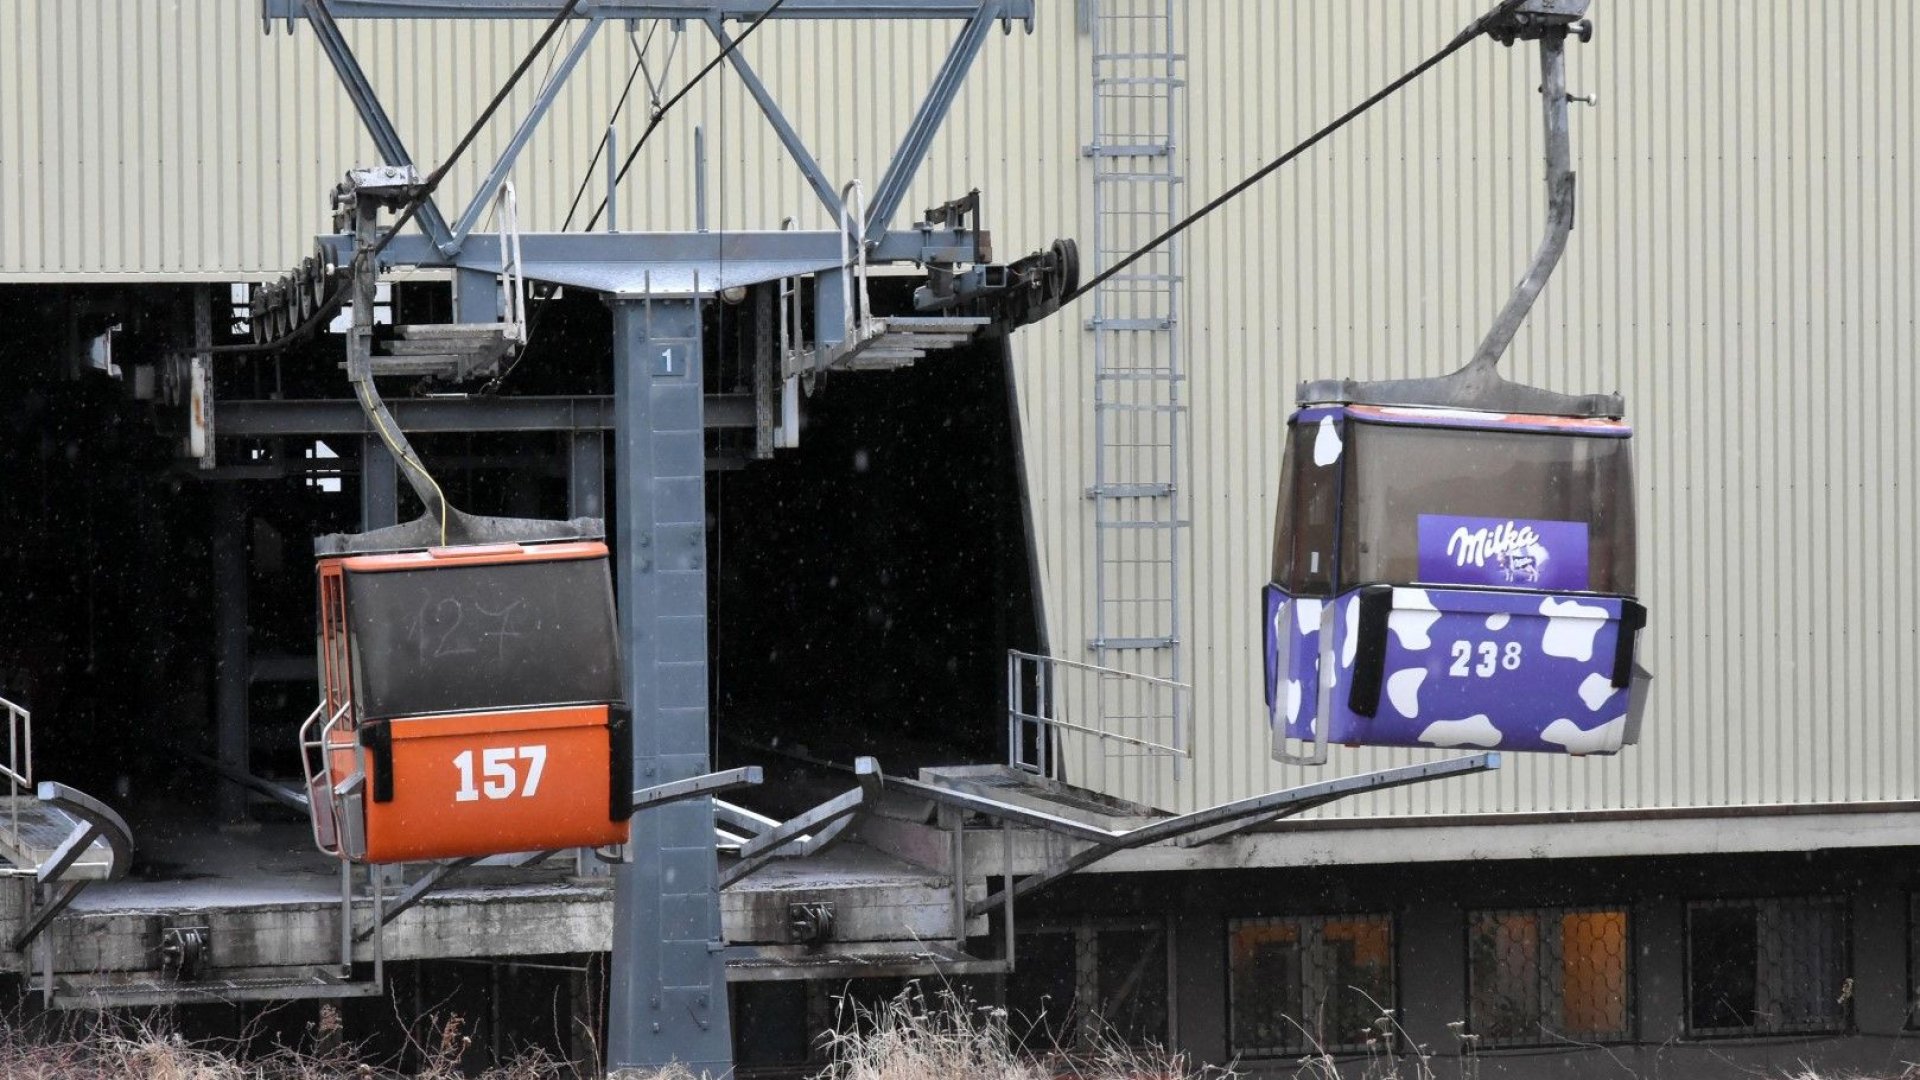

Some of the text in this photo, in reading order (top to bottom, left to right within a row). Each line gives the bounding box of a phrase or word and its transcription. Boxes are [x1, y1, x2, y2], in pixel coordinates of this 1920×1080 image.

[661, 349, 673, 372] 1
[1446, 520, 1540, 567] Milka
[1449, 640, 1522, 678] 238
[452, 744, 547, 802] 157
